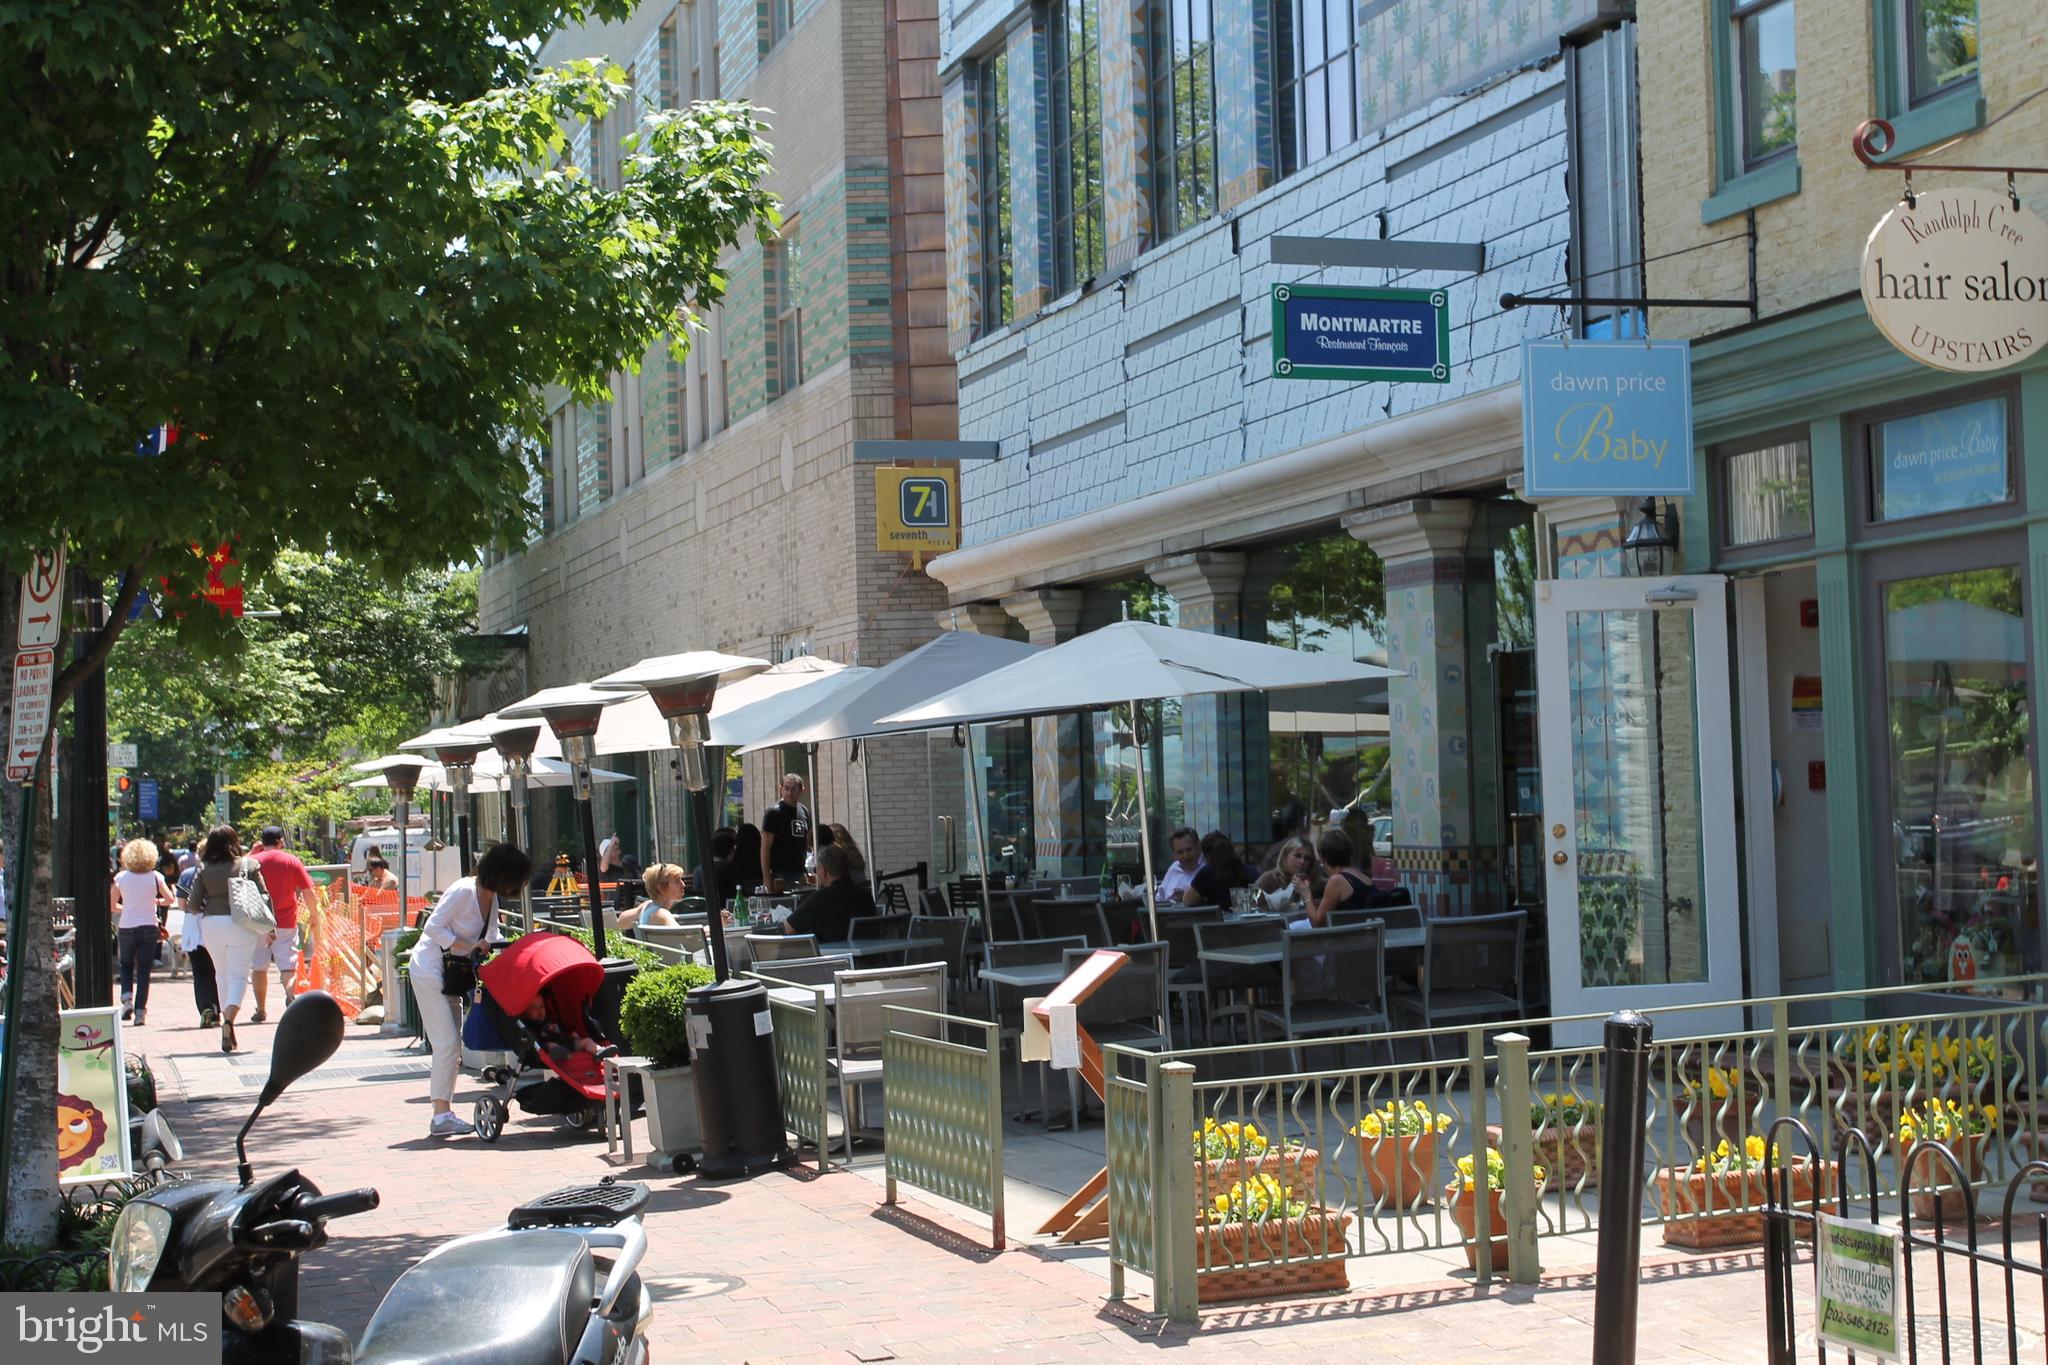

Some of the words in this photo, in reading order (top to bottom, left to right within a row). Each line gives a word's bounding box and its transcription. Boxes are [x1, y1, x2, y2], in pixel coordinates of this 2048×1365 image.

[1900, 198, 1980, 244] Randolph
[1987, 204, 2024, 247] Cree
[1874, 256, 1952, 300] hair
[1316, 335, 1367, 351] Restaurant
[1367, 337, 1409, 354] Français
[1910, 323, 2033, 364] UPSTAIRS
[1551, 371, 1609, 392] dawn
[1616, 372, 1666, 397] price
[1553, 402, 1668, 469] Baby
[1893, 450, 1927, 471] dawn
[1929, 442, 1959, 472] price
[1960, 419, 1999, 457] Baby
[889, 529, 928, 540] seventh
[1827, 1307, 1890, 1337] 202-546-2125
